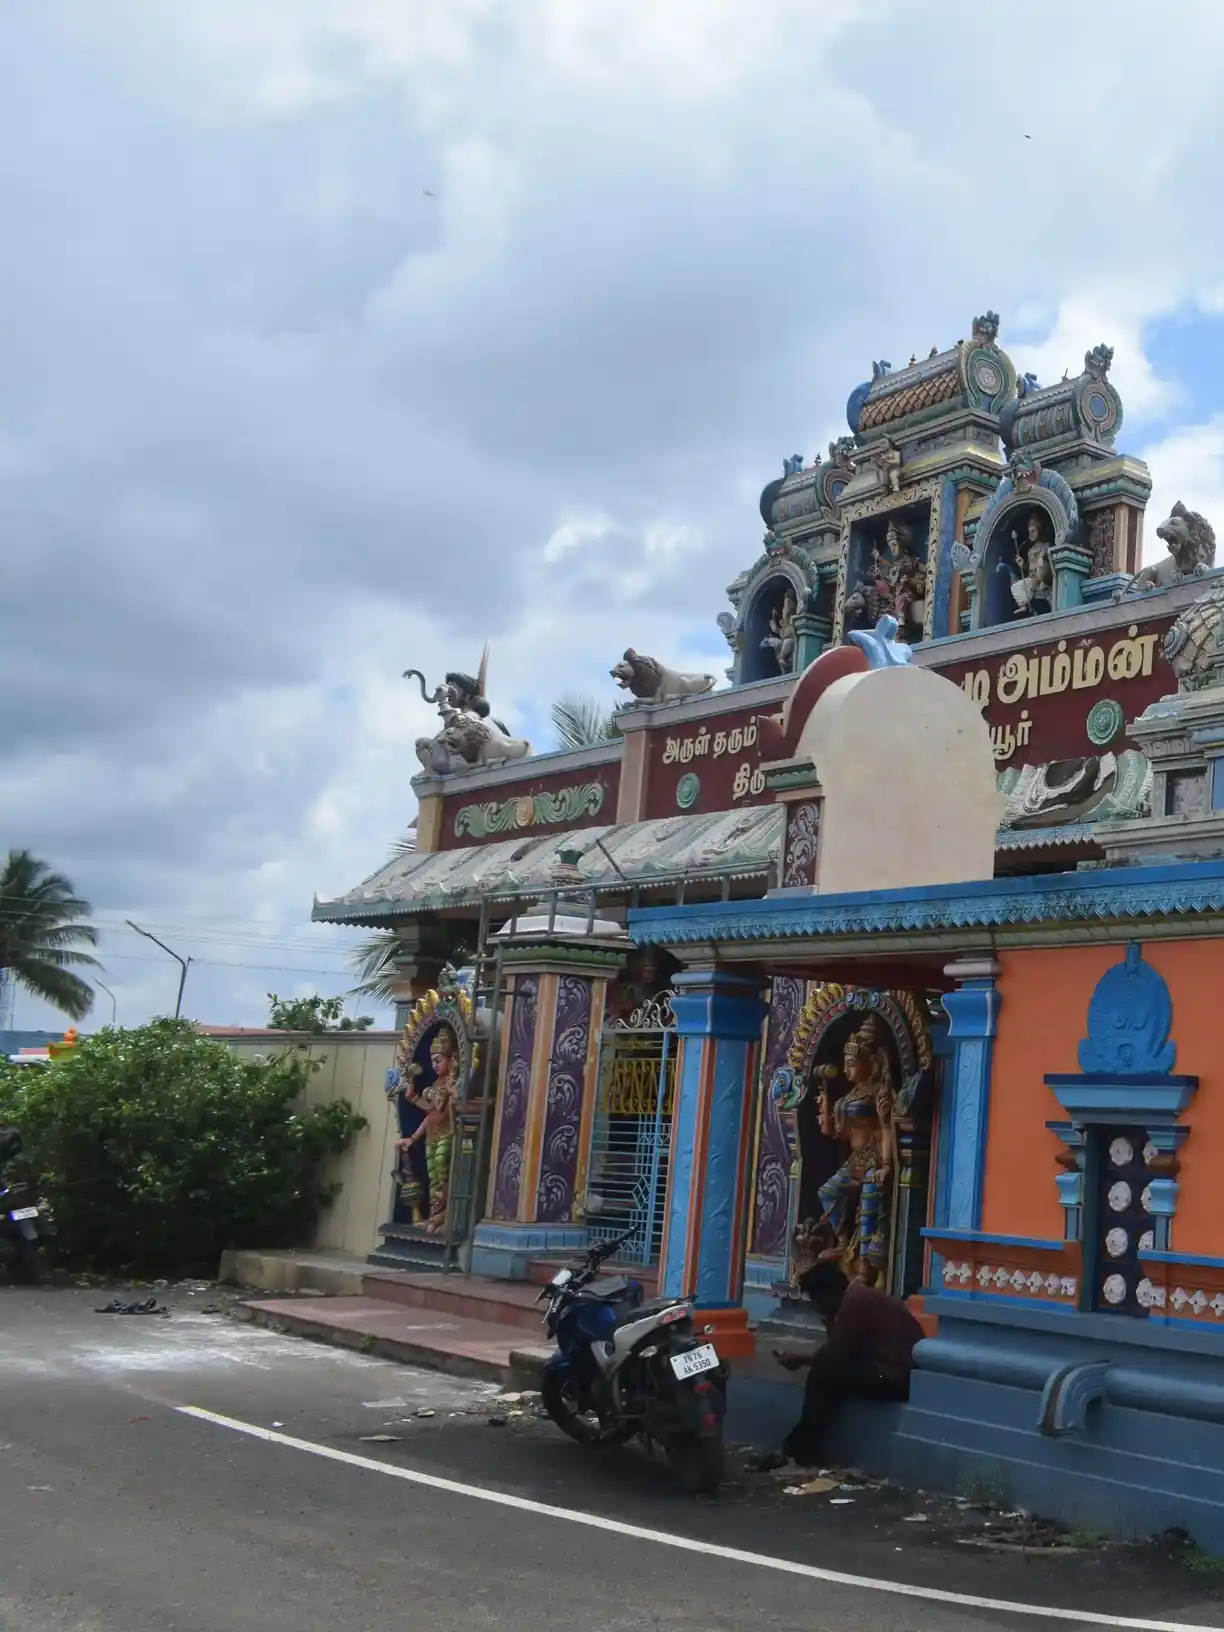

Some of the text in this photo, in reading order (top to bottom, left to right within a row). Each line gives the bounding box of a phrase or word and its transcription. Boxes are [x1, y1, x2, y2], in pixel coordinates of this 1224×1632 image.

[662, 725, 711, 765] அருள்
[712, 715, 757, 760] தரும்
[997, 624, 1159, 705] அம்மன்
[732, 762, 767, 800] திரு
